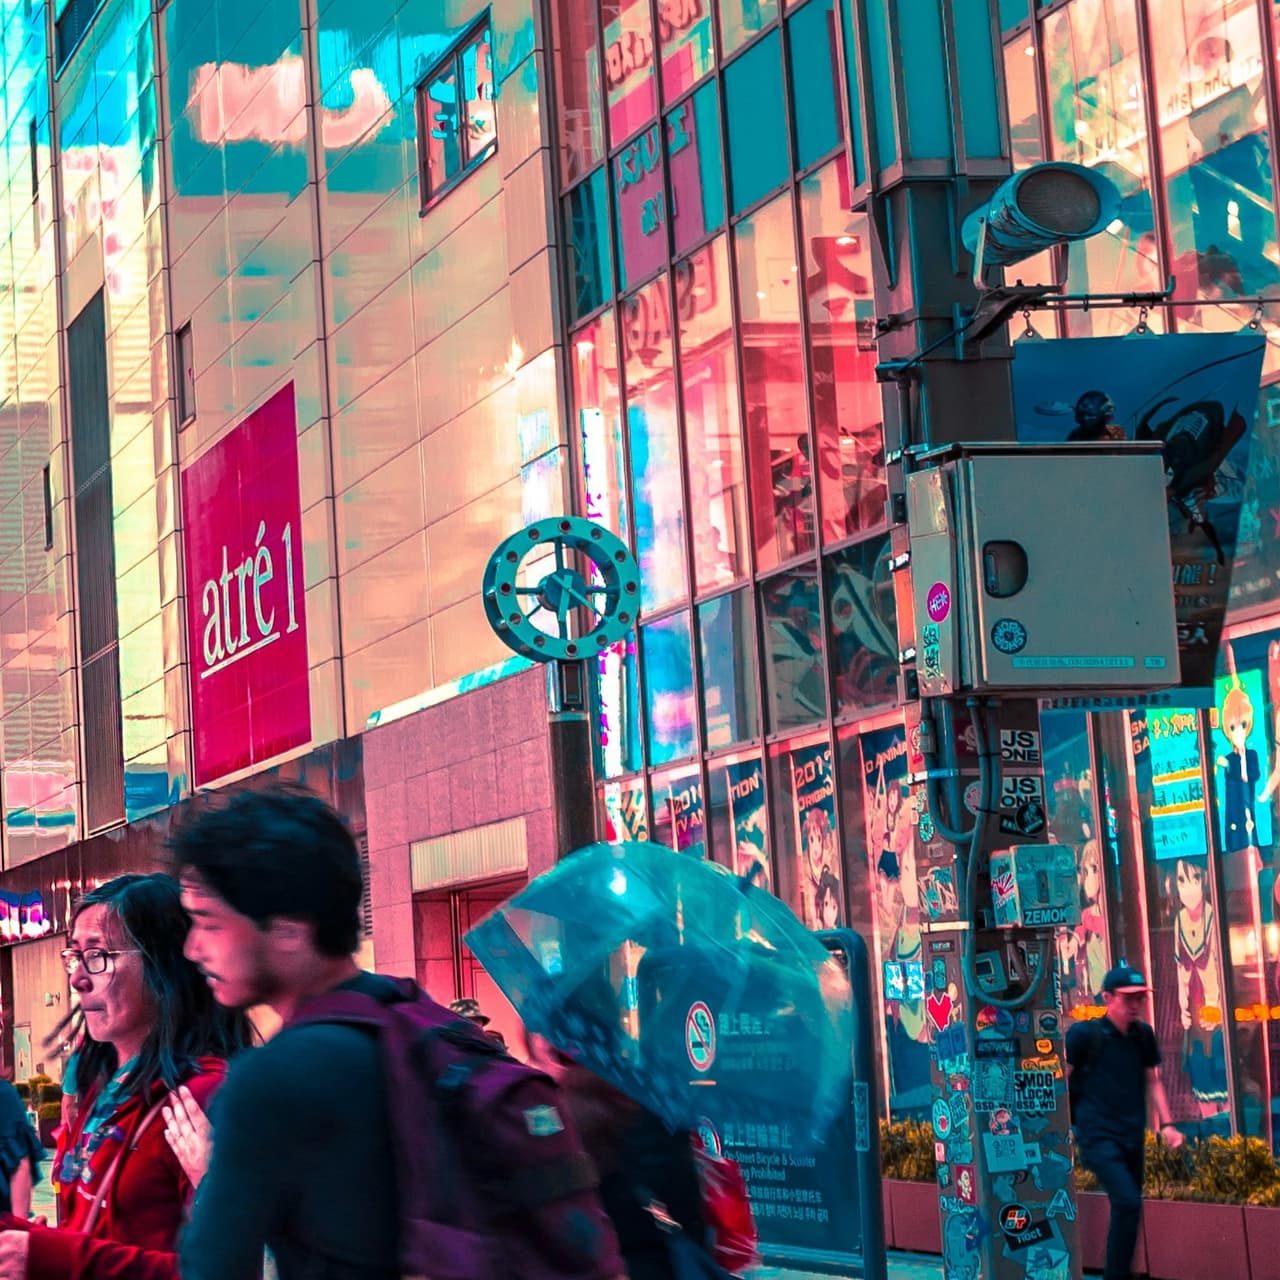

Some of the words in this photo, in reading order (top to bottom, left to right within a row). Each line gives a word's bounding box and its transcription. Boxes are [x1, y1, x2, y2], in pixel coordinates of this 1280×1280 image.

[1003, 732, 1034, 748] JS
[1001, 750, 1039, 761] ONE
[1005, 778, 1036, 794] JS
